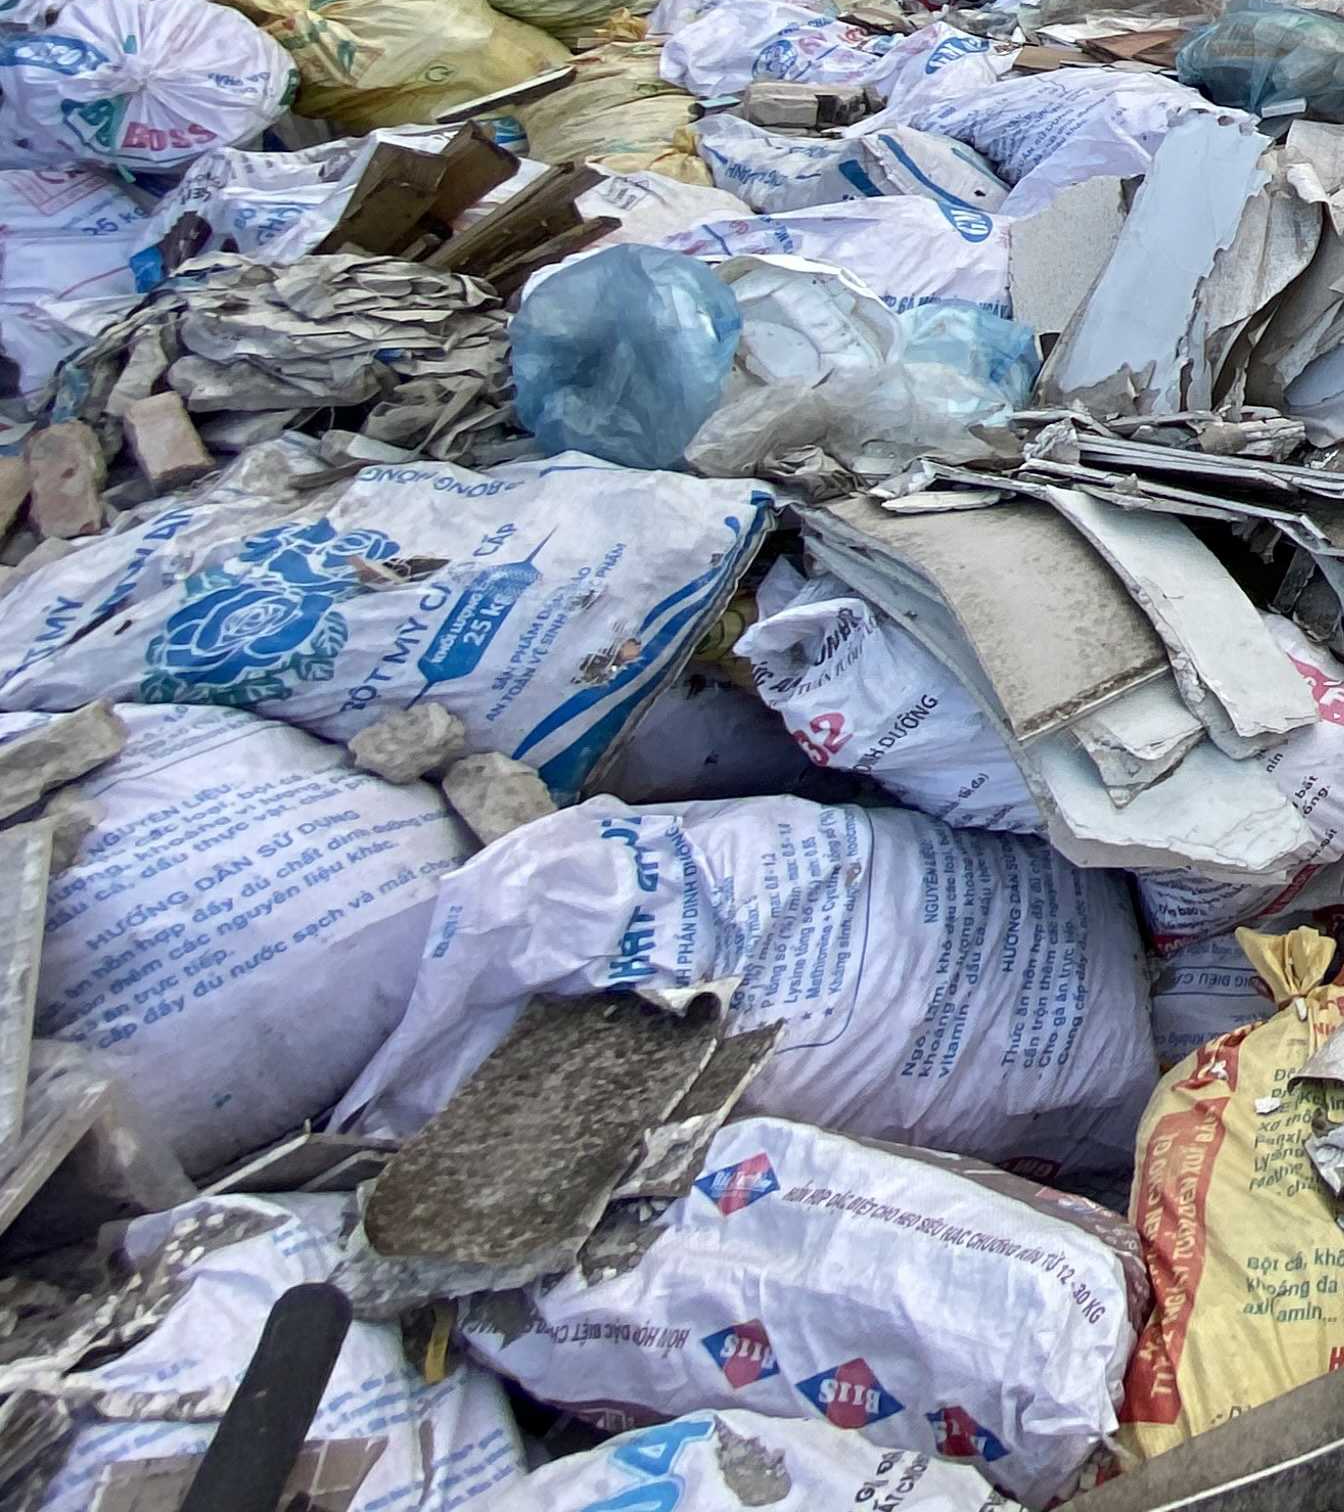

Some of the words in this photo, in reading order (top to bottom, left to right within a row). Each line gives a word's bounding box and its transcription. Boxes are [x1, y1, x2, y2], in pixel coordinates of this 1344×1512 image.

[459, 610, 494, 651] 25
[879, 689, 940, 751] DƯỠNG
[81, 881, 192, 953] HƯỚNG
[190, 848, 253, 895] DẪN
[253, 825, 297, 860] SỬ
[188, 891, 237, 929] đầy
[270, 844, 323, 882] chất
[213, 881, 303, 940] nguyên
[301, 856, 347, 890] liệu
[677, 878, 700, 919] DINH
[225, 935, 290, 981] nước
[288, 902, 348, 947] sạch
[1081, 1295, 1106, 1326] KG
